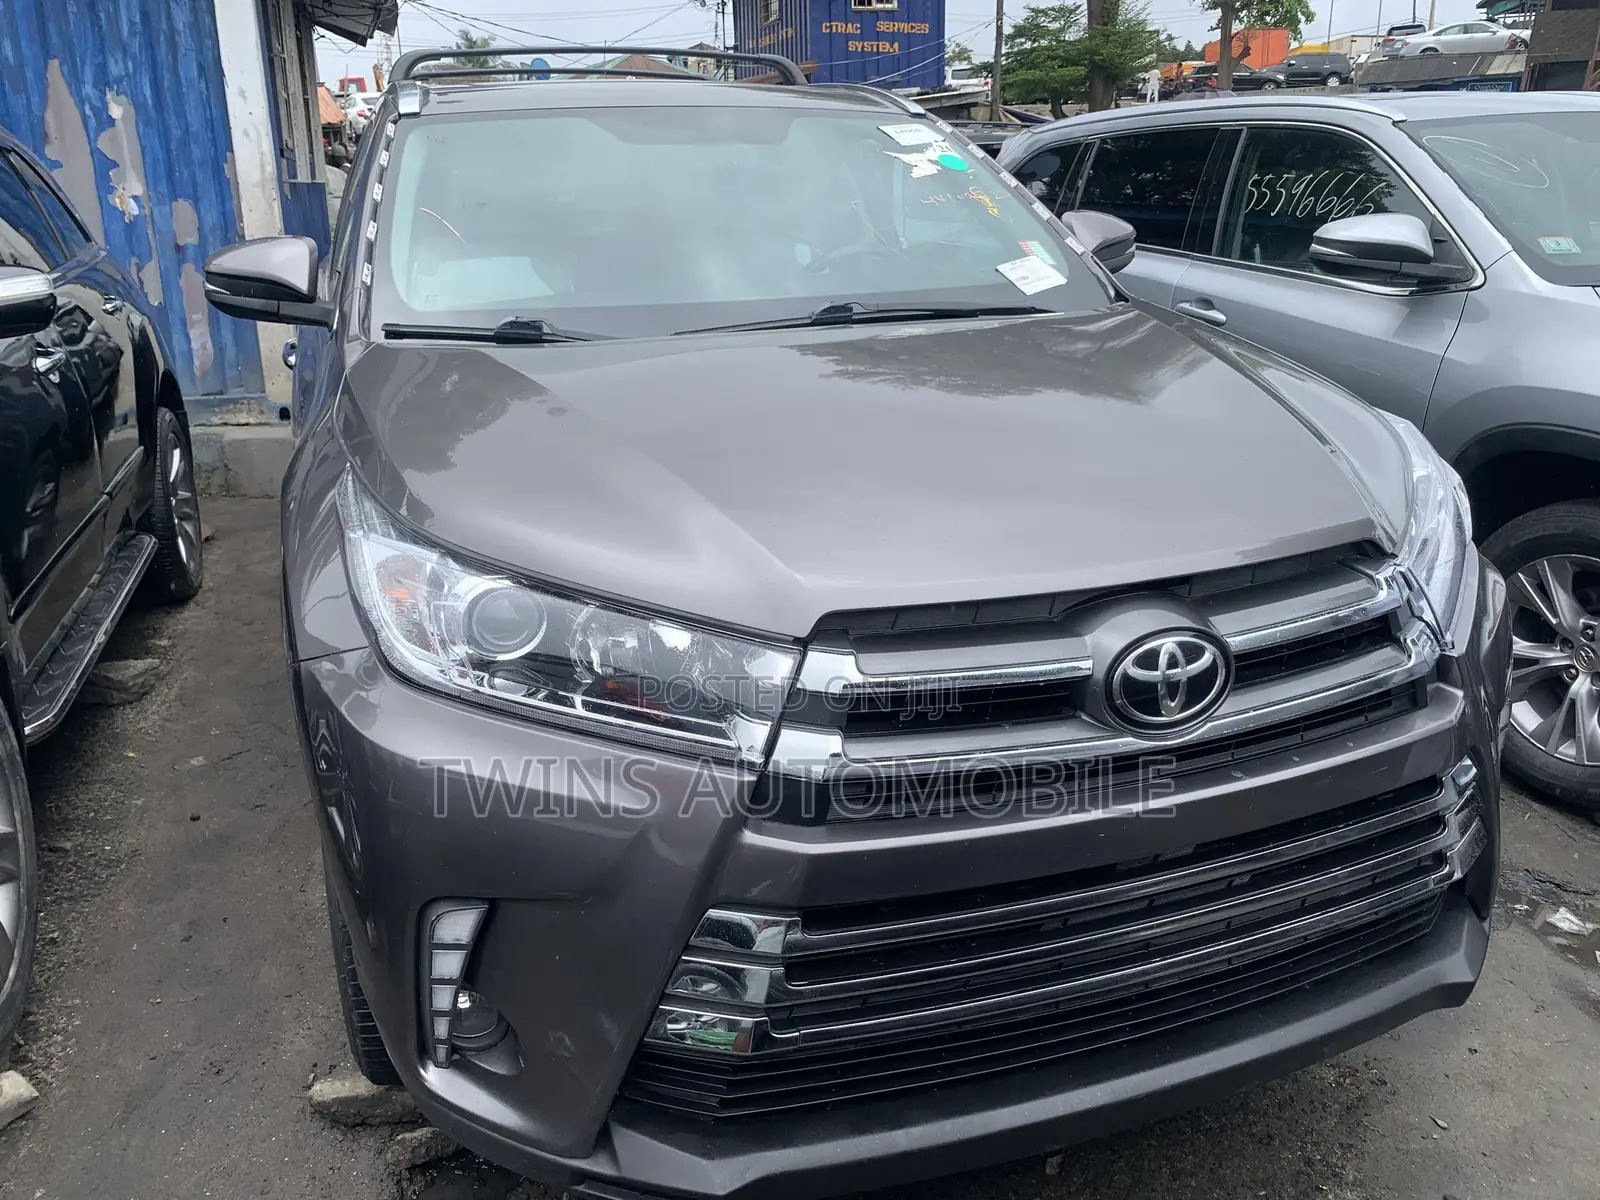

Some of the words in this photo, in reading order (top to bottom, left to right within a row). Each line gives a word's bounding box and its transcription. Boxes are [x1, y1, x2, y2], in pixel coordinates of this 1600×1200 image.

[822, 22, 861, 34] CTRAC
[875, 20, 930, 34] SERVICES
[848, 40, 900, 53] SYSTEM
